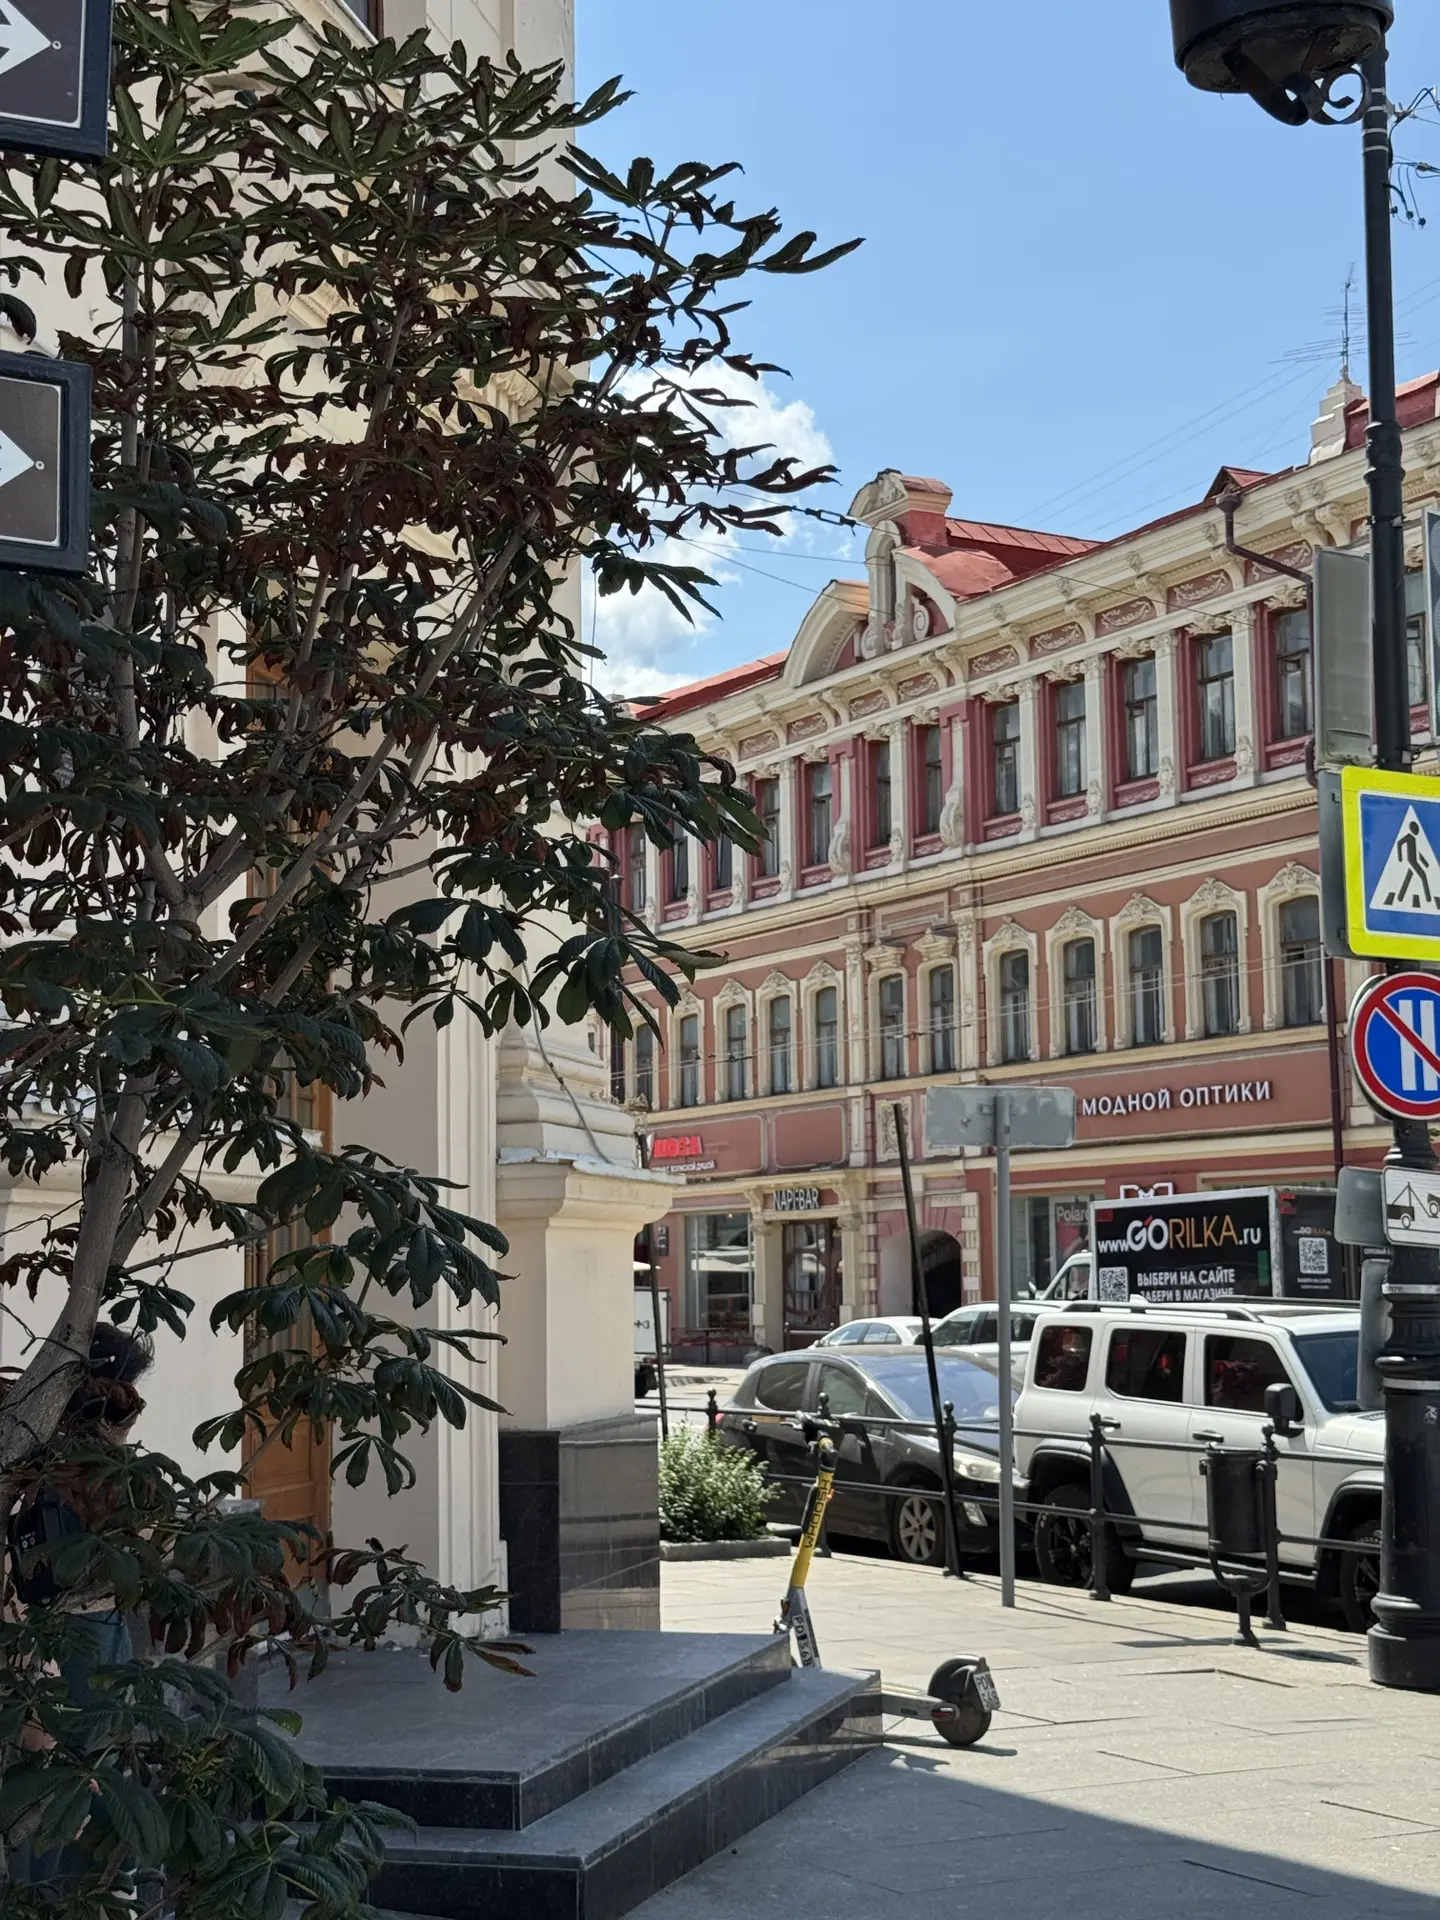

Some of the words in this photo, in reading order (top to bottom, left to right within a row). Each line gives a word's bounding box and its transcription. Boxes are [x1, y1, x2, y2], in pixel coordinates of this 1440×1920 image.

[1082, 1088, 1171, 1116] МОДНОЙ
[1179, 1080, 1271, 1108] ОПТИКИ
[1137, 1270, 1179, 1287] ВЫБЕРИ
[1180, 1270, 1197, 1285] НА
[1199, 1266, 1236, 1284] САЙТЕ
[1175, 1289, 1182, 1302] В
[803, 1479, 829, 1549] WHOOSH
